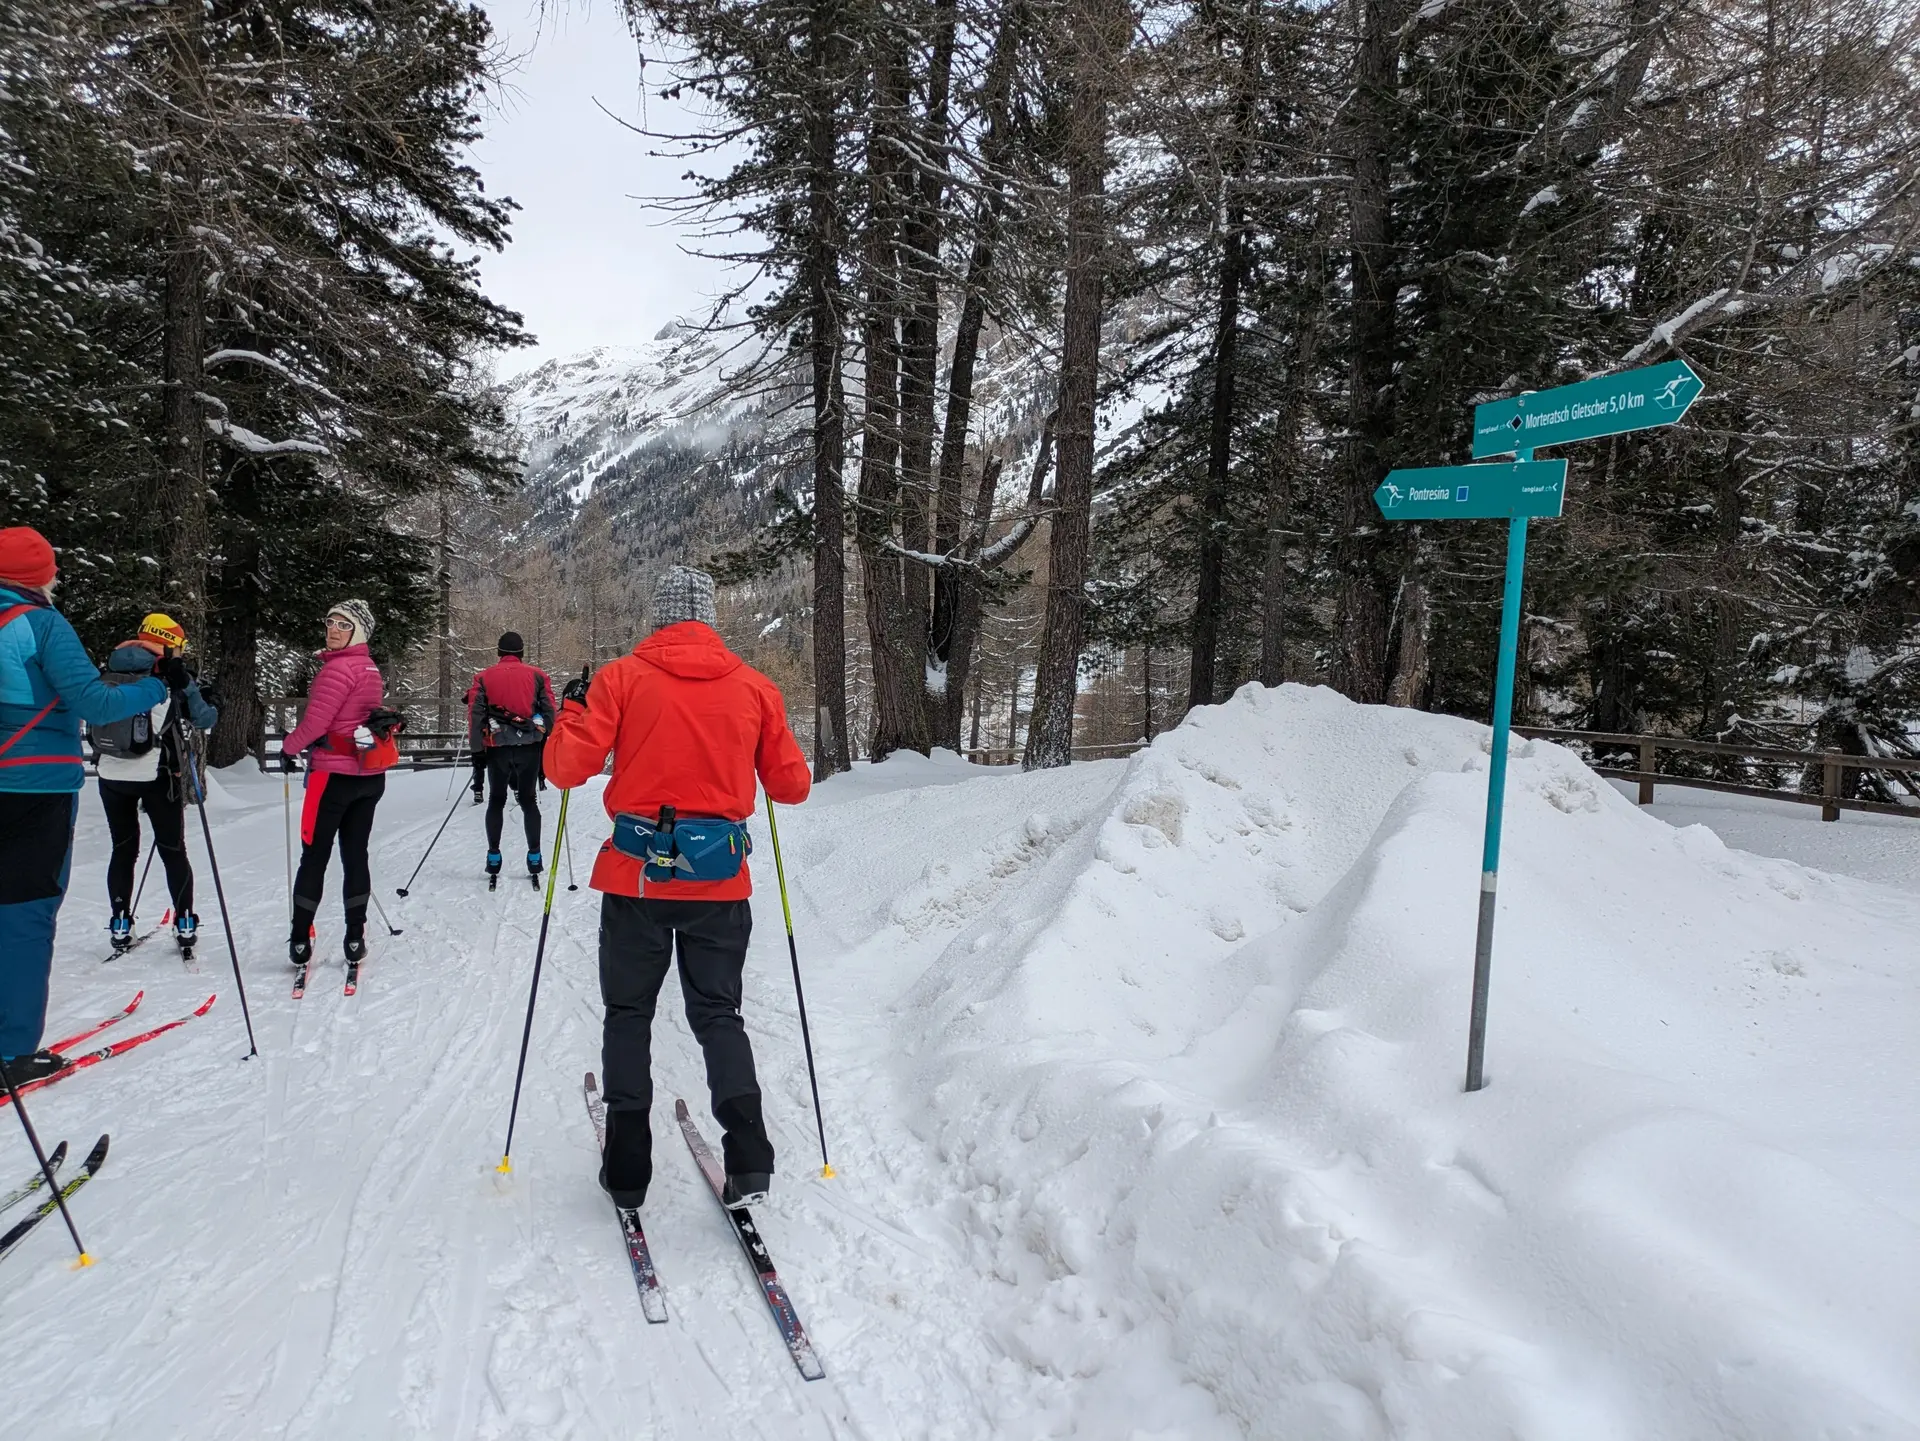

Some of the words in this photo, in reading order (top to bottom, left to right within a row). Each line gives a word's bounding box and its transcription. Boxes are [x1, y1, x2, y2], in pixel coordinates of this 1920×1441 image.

[1525, 404, 1569, 429] Morteratsch
[1571, 398, 1608, 420] Gletscher
[1609, 394, 1626, 414] 5,0
[1627, 392, 1644, 408] km
[1408, 486, 1450, 501] Pontresina
[1522, 485, 1553, 494] langlauf.ch
[151, 626, 176, 642] uvex
[40, 1174, 91, 1215] FISHER
